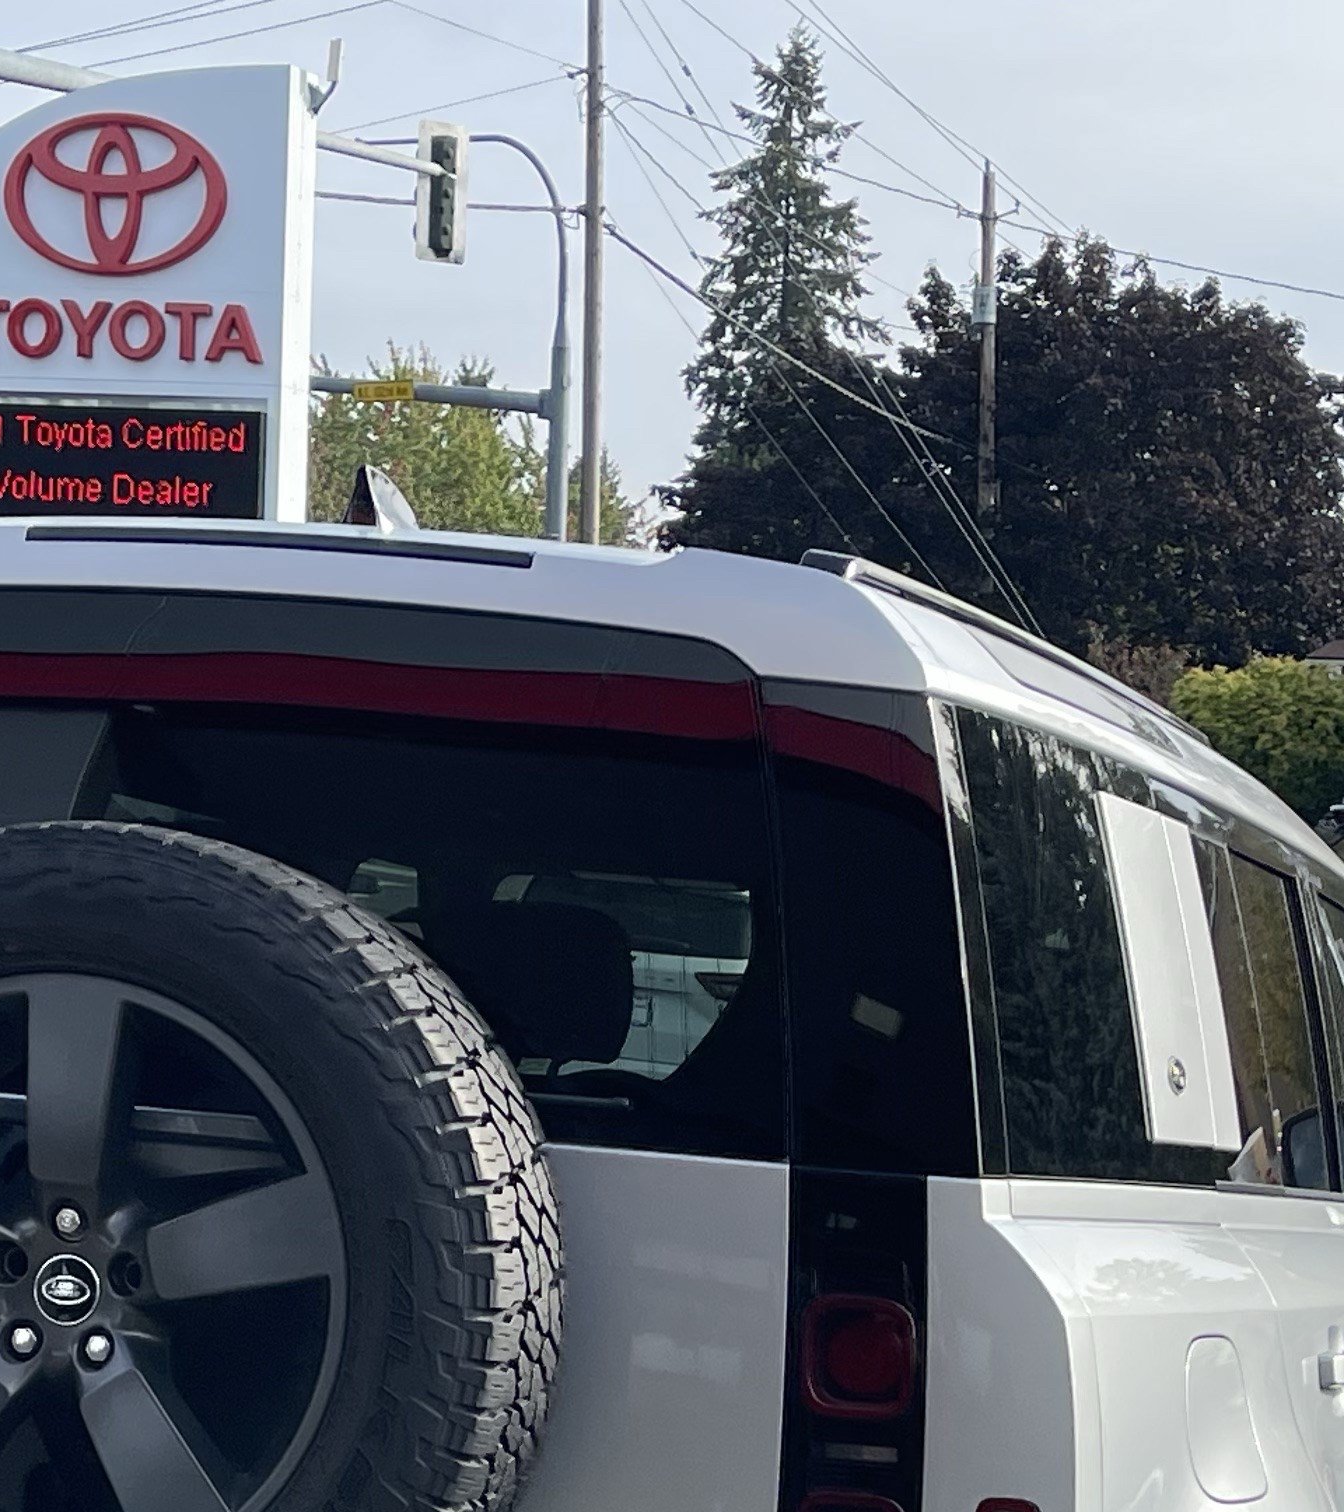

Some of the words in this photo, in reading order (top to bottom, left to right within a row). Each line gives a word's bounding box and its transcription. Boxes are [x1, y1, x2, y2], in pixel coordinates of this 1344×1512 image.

[15, 415, 113, 452] Toyota
[120, 418, 247, 453] Certified
[112, 474, 214, 508] Dealer
